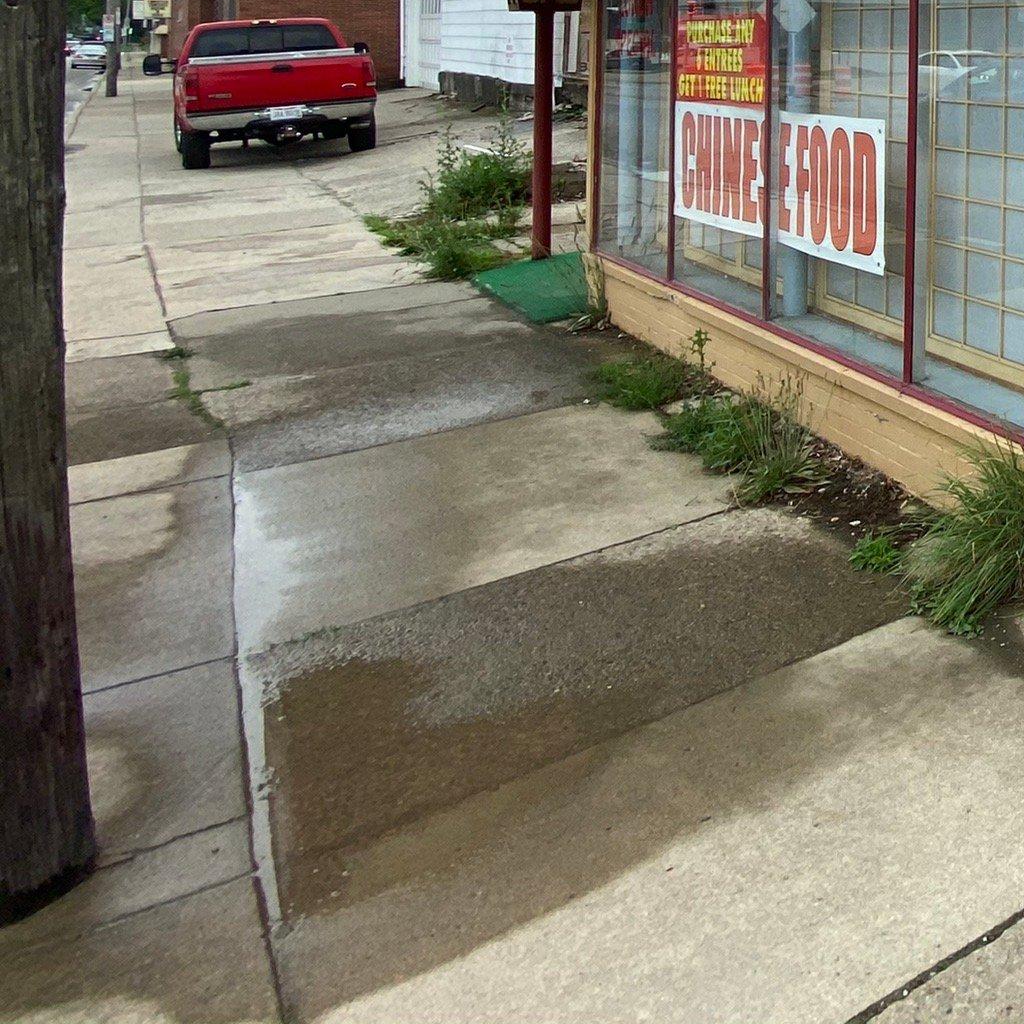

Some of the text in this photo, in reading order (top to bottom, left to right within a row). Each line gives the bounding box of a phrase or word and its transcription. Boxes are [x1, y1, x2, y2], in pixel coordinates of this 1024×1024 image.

[686, 18, 756, 44] PURCHASE ANY
[704, 47, 743, 73] ENTREES
[679, 73, 696, 97] GET
[706, 75, 728, 100] FREE
[730, 77, 764, 103] LUNCH
[796, 124, 878, 257] FOOD
